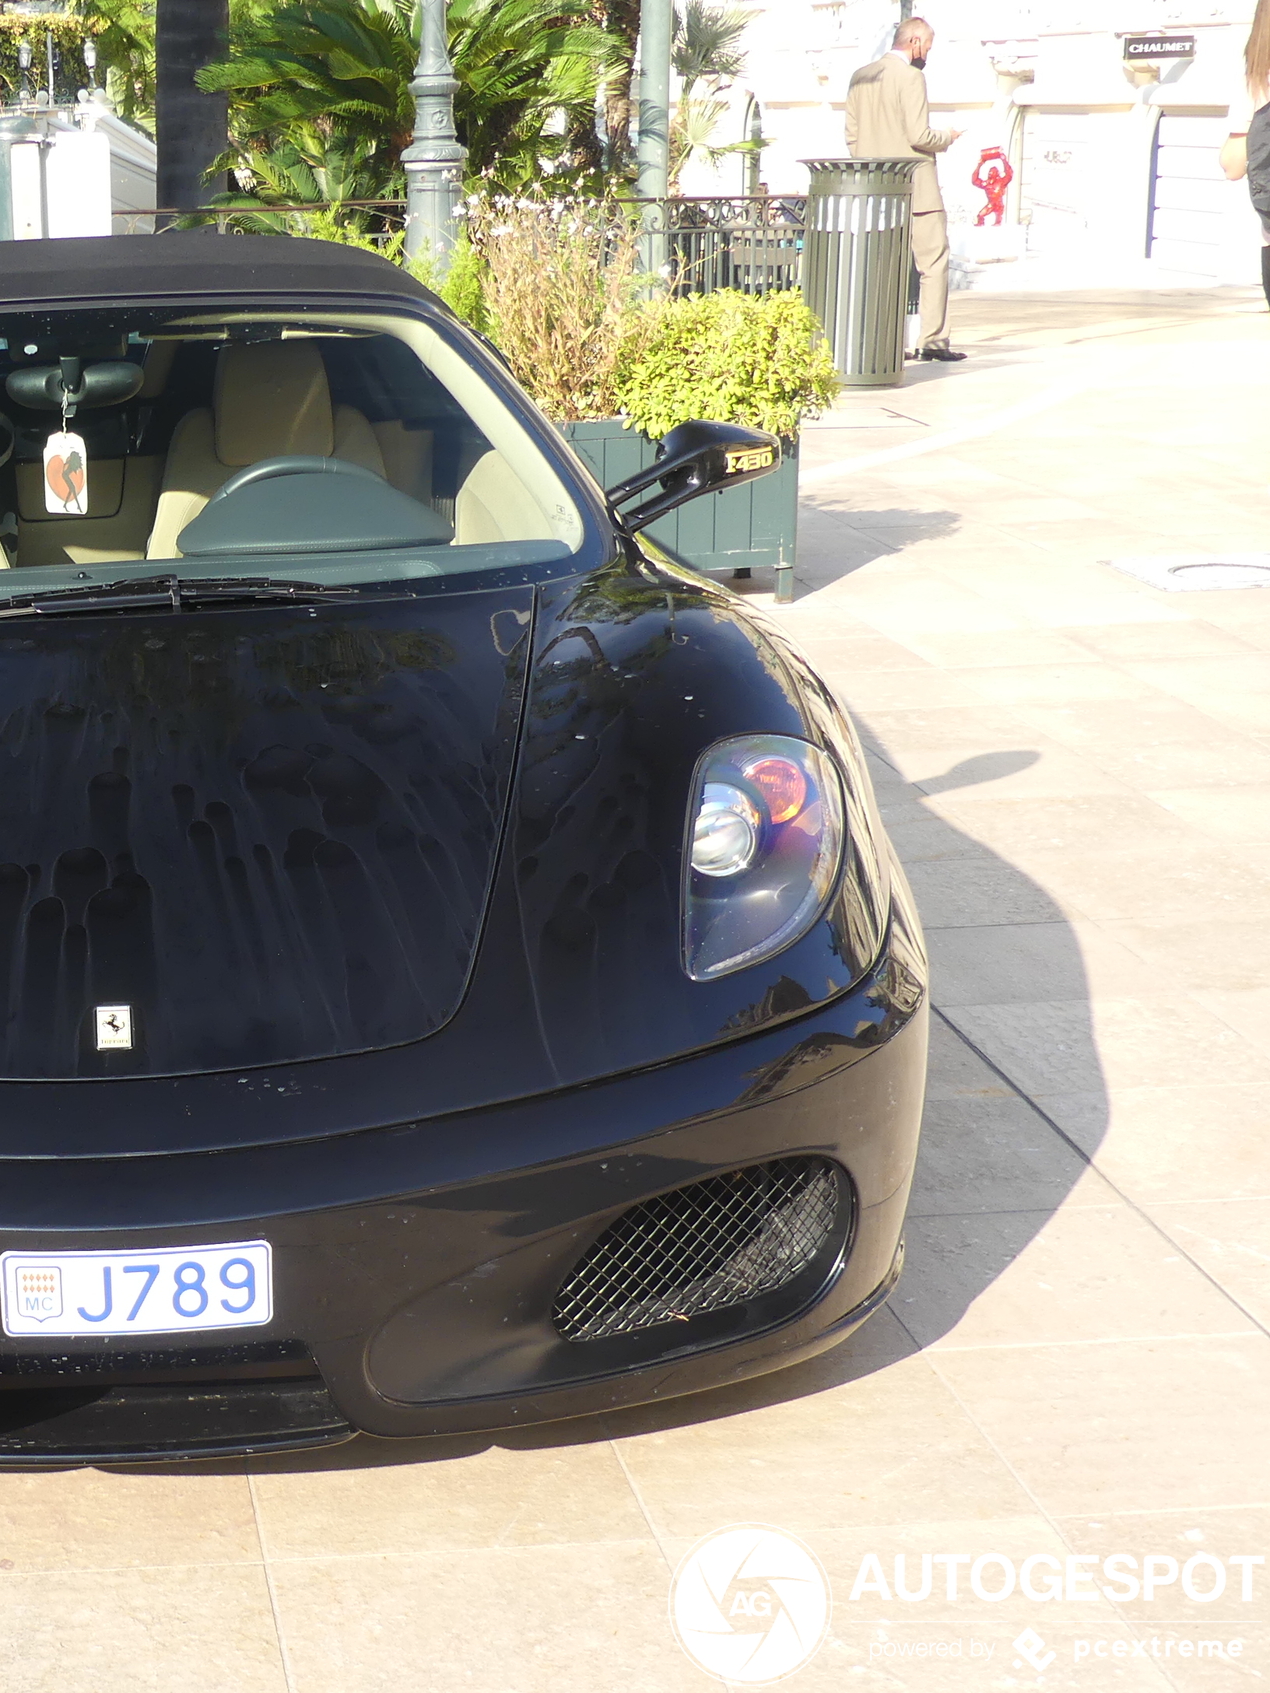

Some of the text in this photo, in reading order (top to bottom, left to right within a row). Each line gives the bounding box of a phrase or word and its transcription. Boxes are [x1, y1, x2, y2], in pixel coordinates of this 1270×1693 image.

[1129, 42, 1193, 53] CHAUMET
[725, 445, 773, 473] F430
[77, 1258, 256, 1322] J789
[25, 1297, 54, 1311] MC
